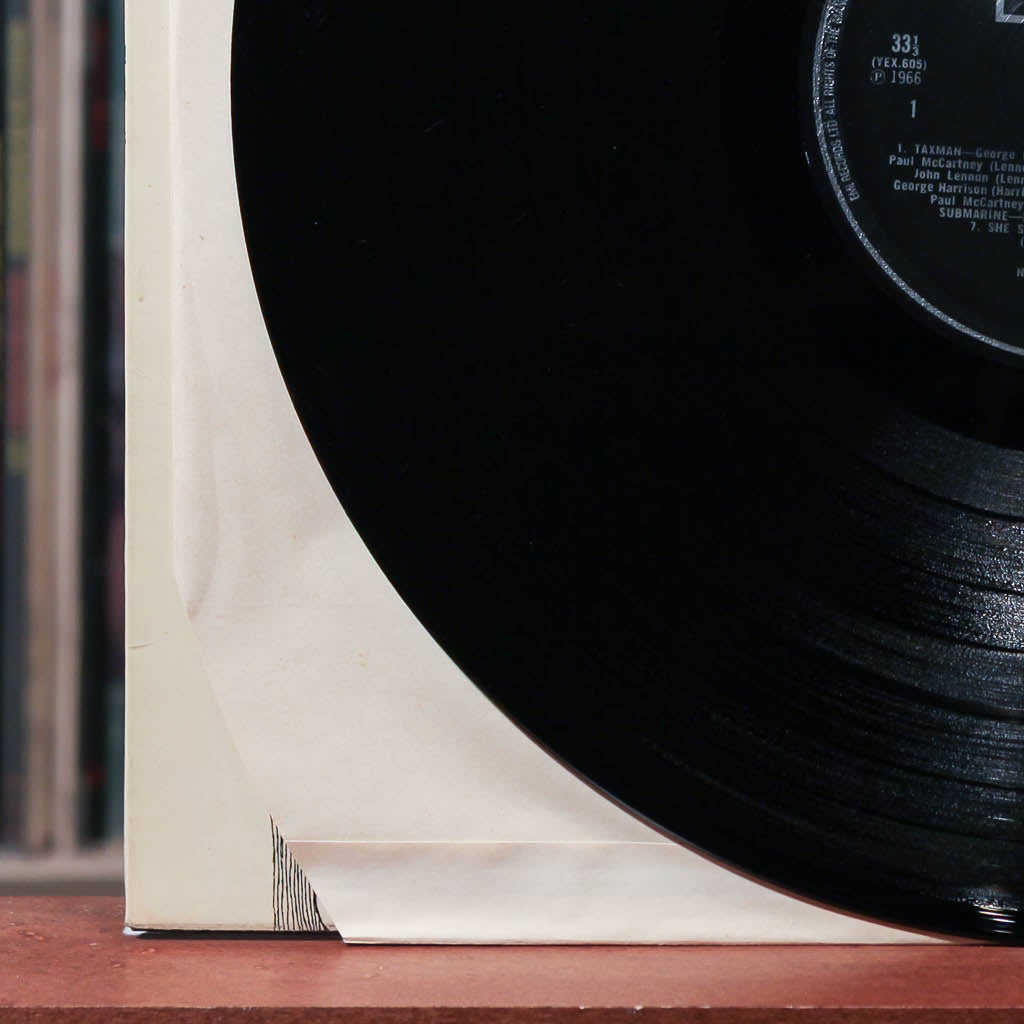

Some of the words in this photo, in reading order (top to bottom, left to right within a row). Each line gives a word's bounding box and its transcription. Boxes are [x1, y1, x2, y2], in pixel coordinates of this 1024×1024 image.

[871, 56, 927, 71] (YEX.605)
[823, 61, 835, 95] RIGHTS
[891, 70, 921, 85] 1966
[824, 98, 836, 115] ALL
[910, 99, 917, 119] 1
[889, 154, 914, 166] Paul
[921, 156, 982, 172] McCartney
[913, 168, 940, 180] John
[947, 170, 989, 182] Lennon
[893, 180, 934, 194] George
[938, 182, 988, 195] Harrison
[930, 194, 956, 206] Paul
[963, 196, 1024, 211] McCartney
[987, 222, 1010, 234] SHE
